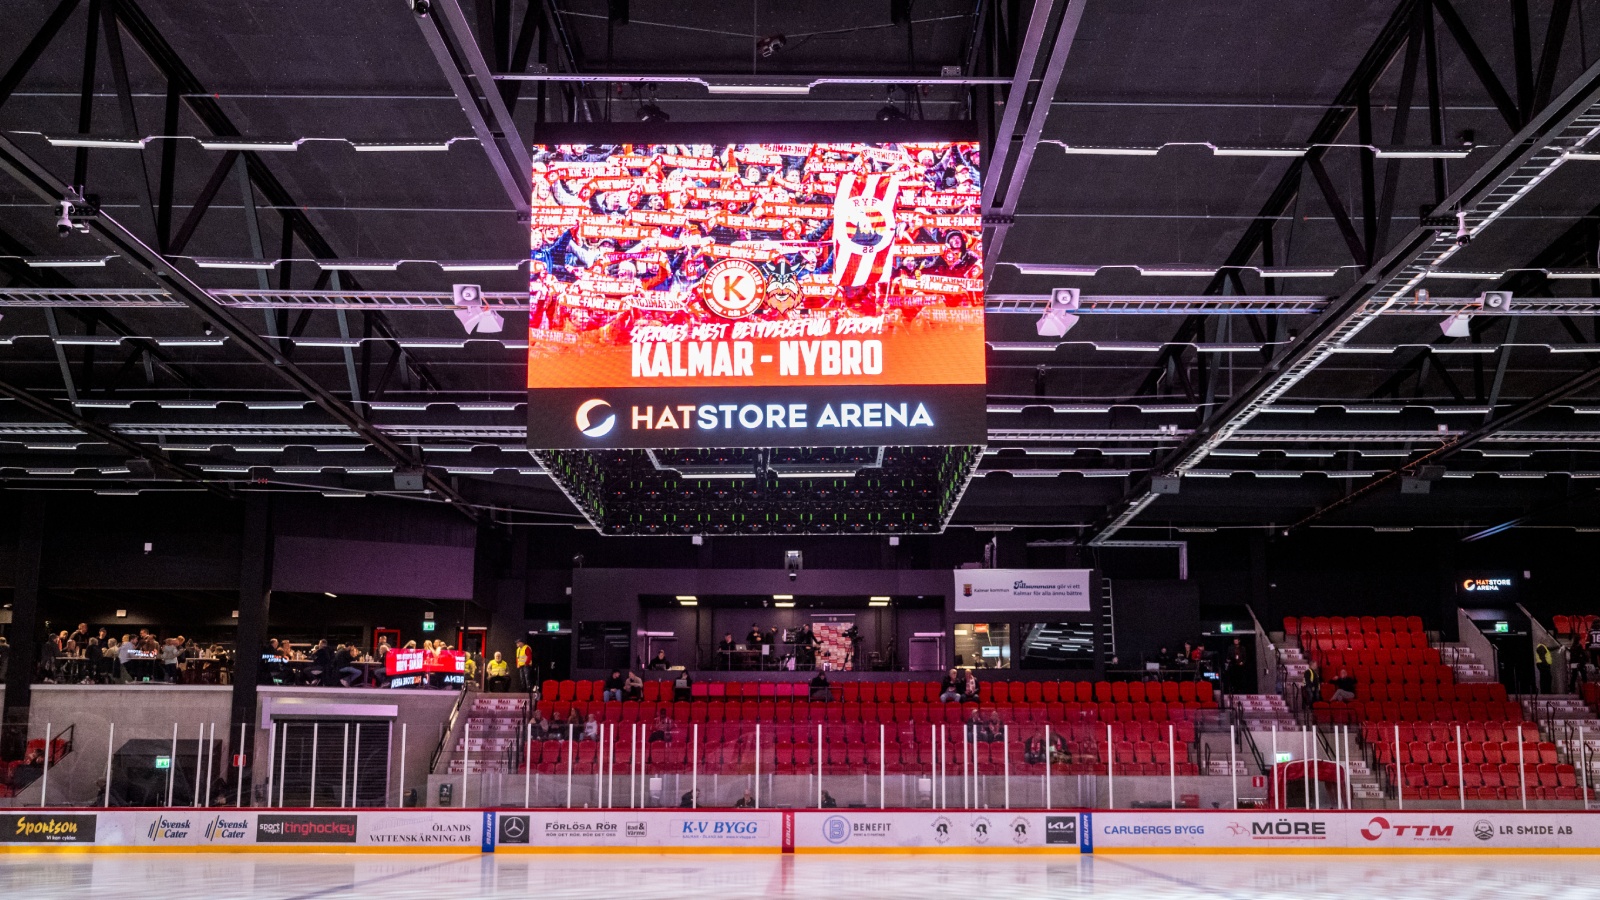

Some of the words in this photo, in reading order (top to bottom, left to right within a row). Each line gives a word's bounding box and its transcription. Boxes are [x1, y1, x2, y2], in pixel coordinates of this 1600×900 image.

[724, 275, 748, 302] K
[691, 323, 730, 341] MEST
[632, 341, 754, 377] KALMAR
[780, 340, 883, 376] NYBRO
[631, 404, 808, 430] HATSTORE
[816, 402, 934, 428] ARENA
[1013, 580, 1056, 590] Tillsammans
[15, 816, 78, 836] Sportson
[161, 819, 191, 829] Svensk
[218, 819, 248, 829] Svensk
[259, 822, 280, 831] sport
[284, 821, 355, 836] tinghockey
[432, 822, 471, 832] ÖLANDS
[545, 821, 592, 830] FÖRLÖSA
[596, 821, 618, 830] RÖR
[682, 821, 709, 834] K-V
[713, 821, 758, 834] BYGG
[853, 822, 892, 832] BENEFIT
[1252, 819, 1326, 835] MÖRE
[164, 829, 188, 838] Cater
[221, 829, 246, 838] Cater
[1104, 825, 1172, 835] CARLBERGS
[1174, 825, 1205, 835] BYGG
[1392, 825, 1455, 836] TTM
[1499, 825, 1514, 835] LR
[1516, 825, 1554, 835] SMIDE
[1557, 825, 1573, 835] AB
[369, 833, 456, 843] VATTENSKÄRNING
[459, 834, 472, 842] AB
